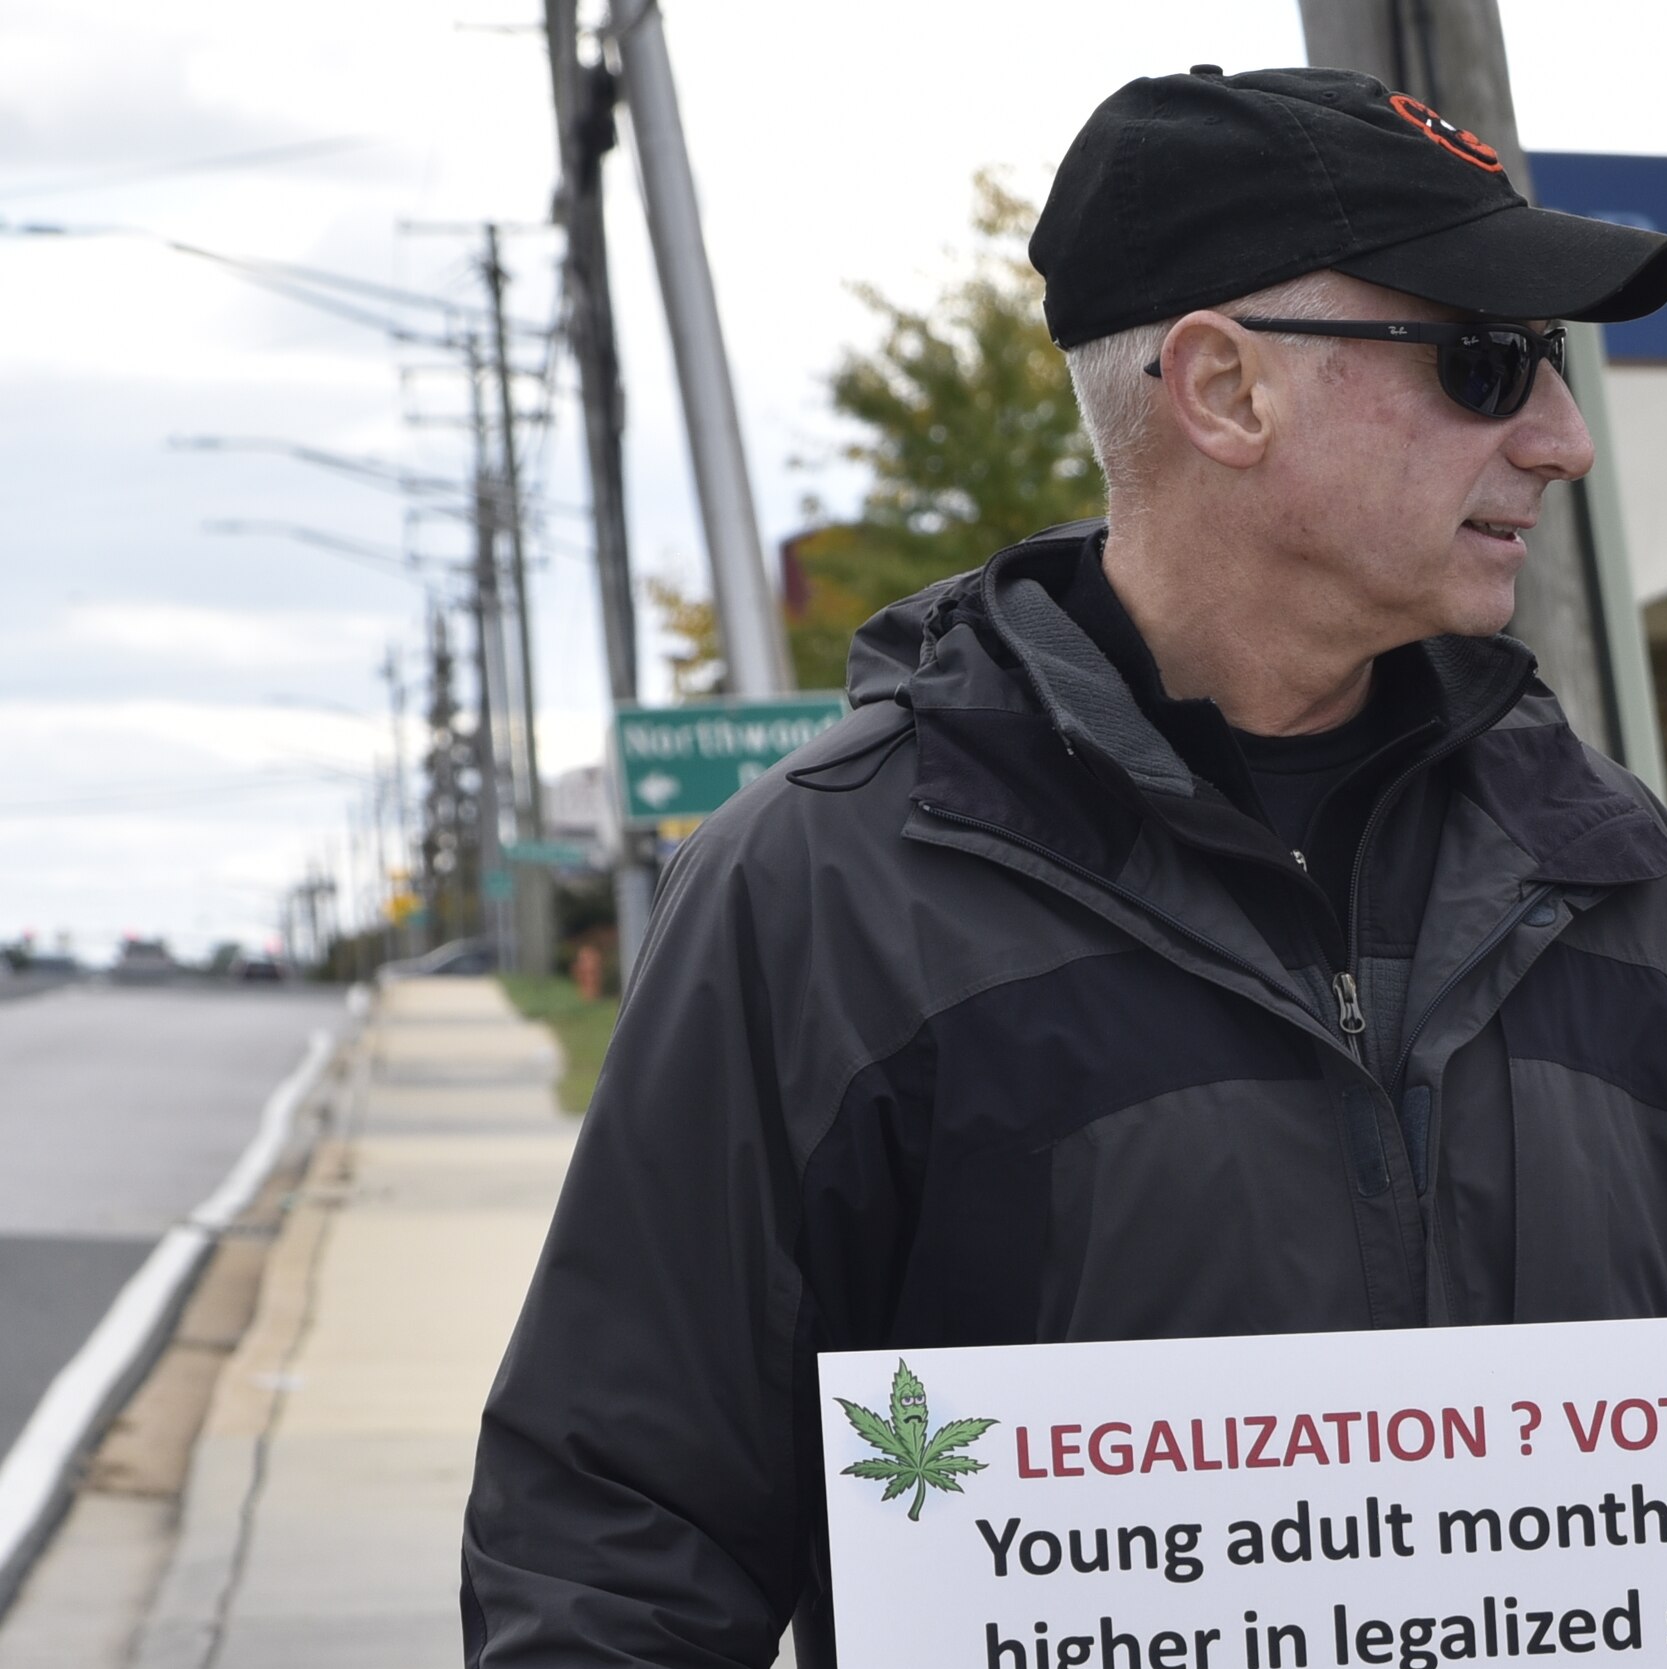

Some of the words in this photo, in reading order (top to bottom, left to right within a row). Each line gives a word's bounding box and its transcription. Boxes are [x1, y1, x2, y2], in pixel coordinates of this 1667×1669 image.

[1015, 1405, 1487, 1479] LEGALIZATION
[1511, 1400, 1542, 1456] ?
[974, 1517, 1204, 1584] Young
[1226, 1496, 1415, 1566] adult
